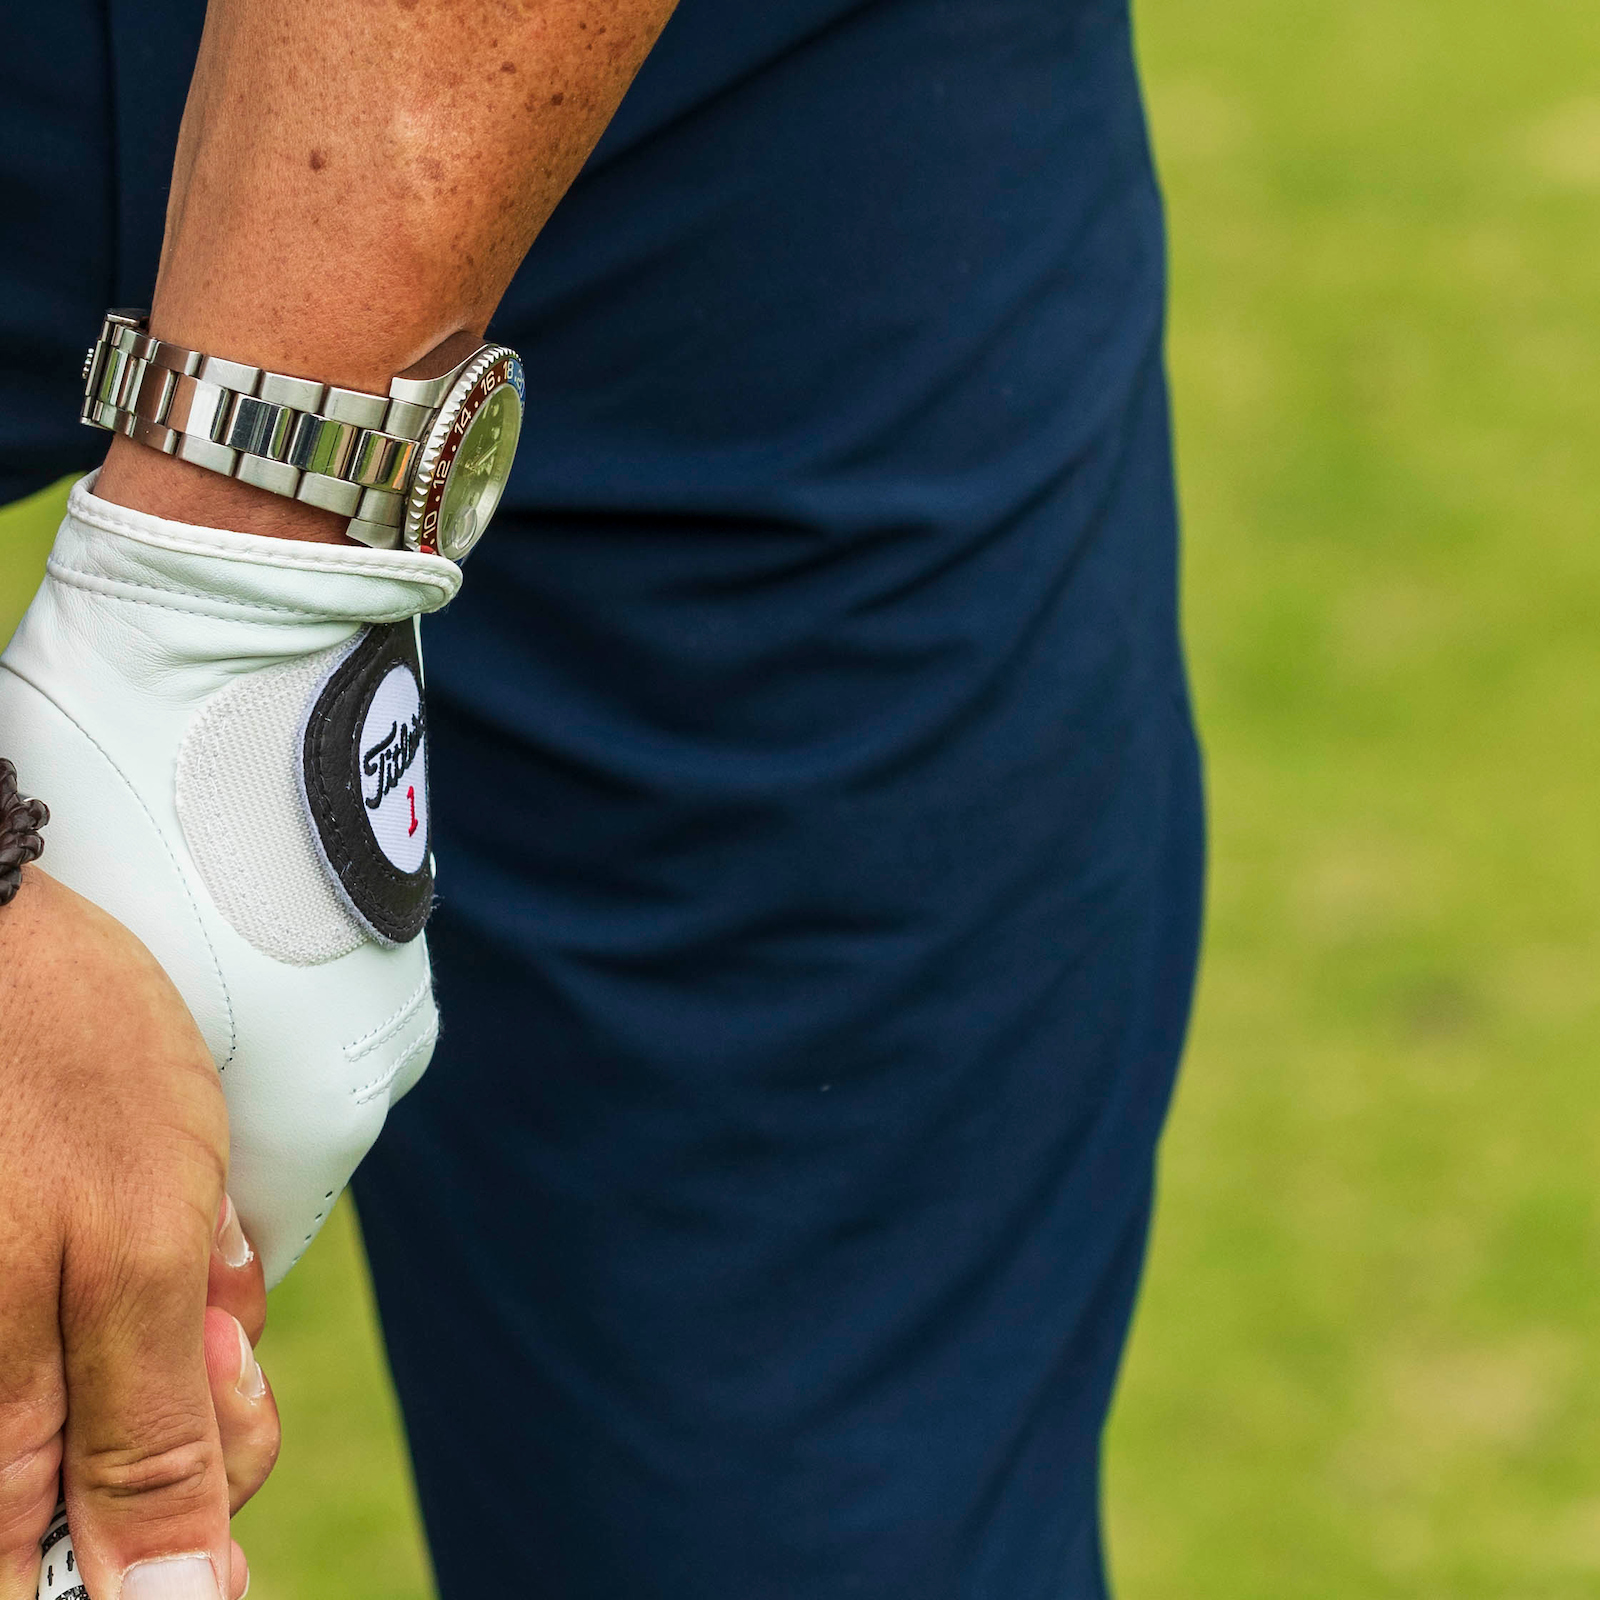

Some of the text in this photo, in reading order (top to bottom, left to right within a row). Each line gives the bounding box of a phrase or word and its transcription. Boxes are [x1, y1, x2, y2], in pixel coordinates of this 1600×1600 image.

[423, 510, 438, 540] 10
[433, 460, 451, 489] 12
[454, 407, 472, 435] 14
[480, 370, 496, 396] 16
[503, 360, 514, 380] 18
[364, 711, 425, 809] Titl
[406, 785, 419, 838] 1
